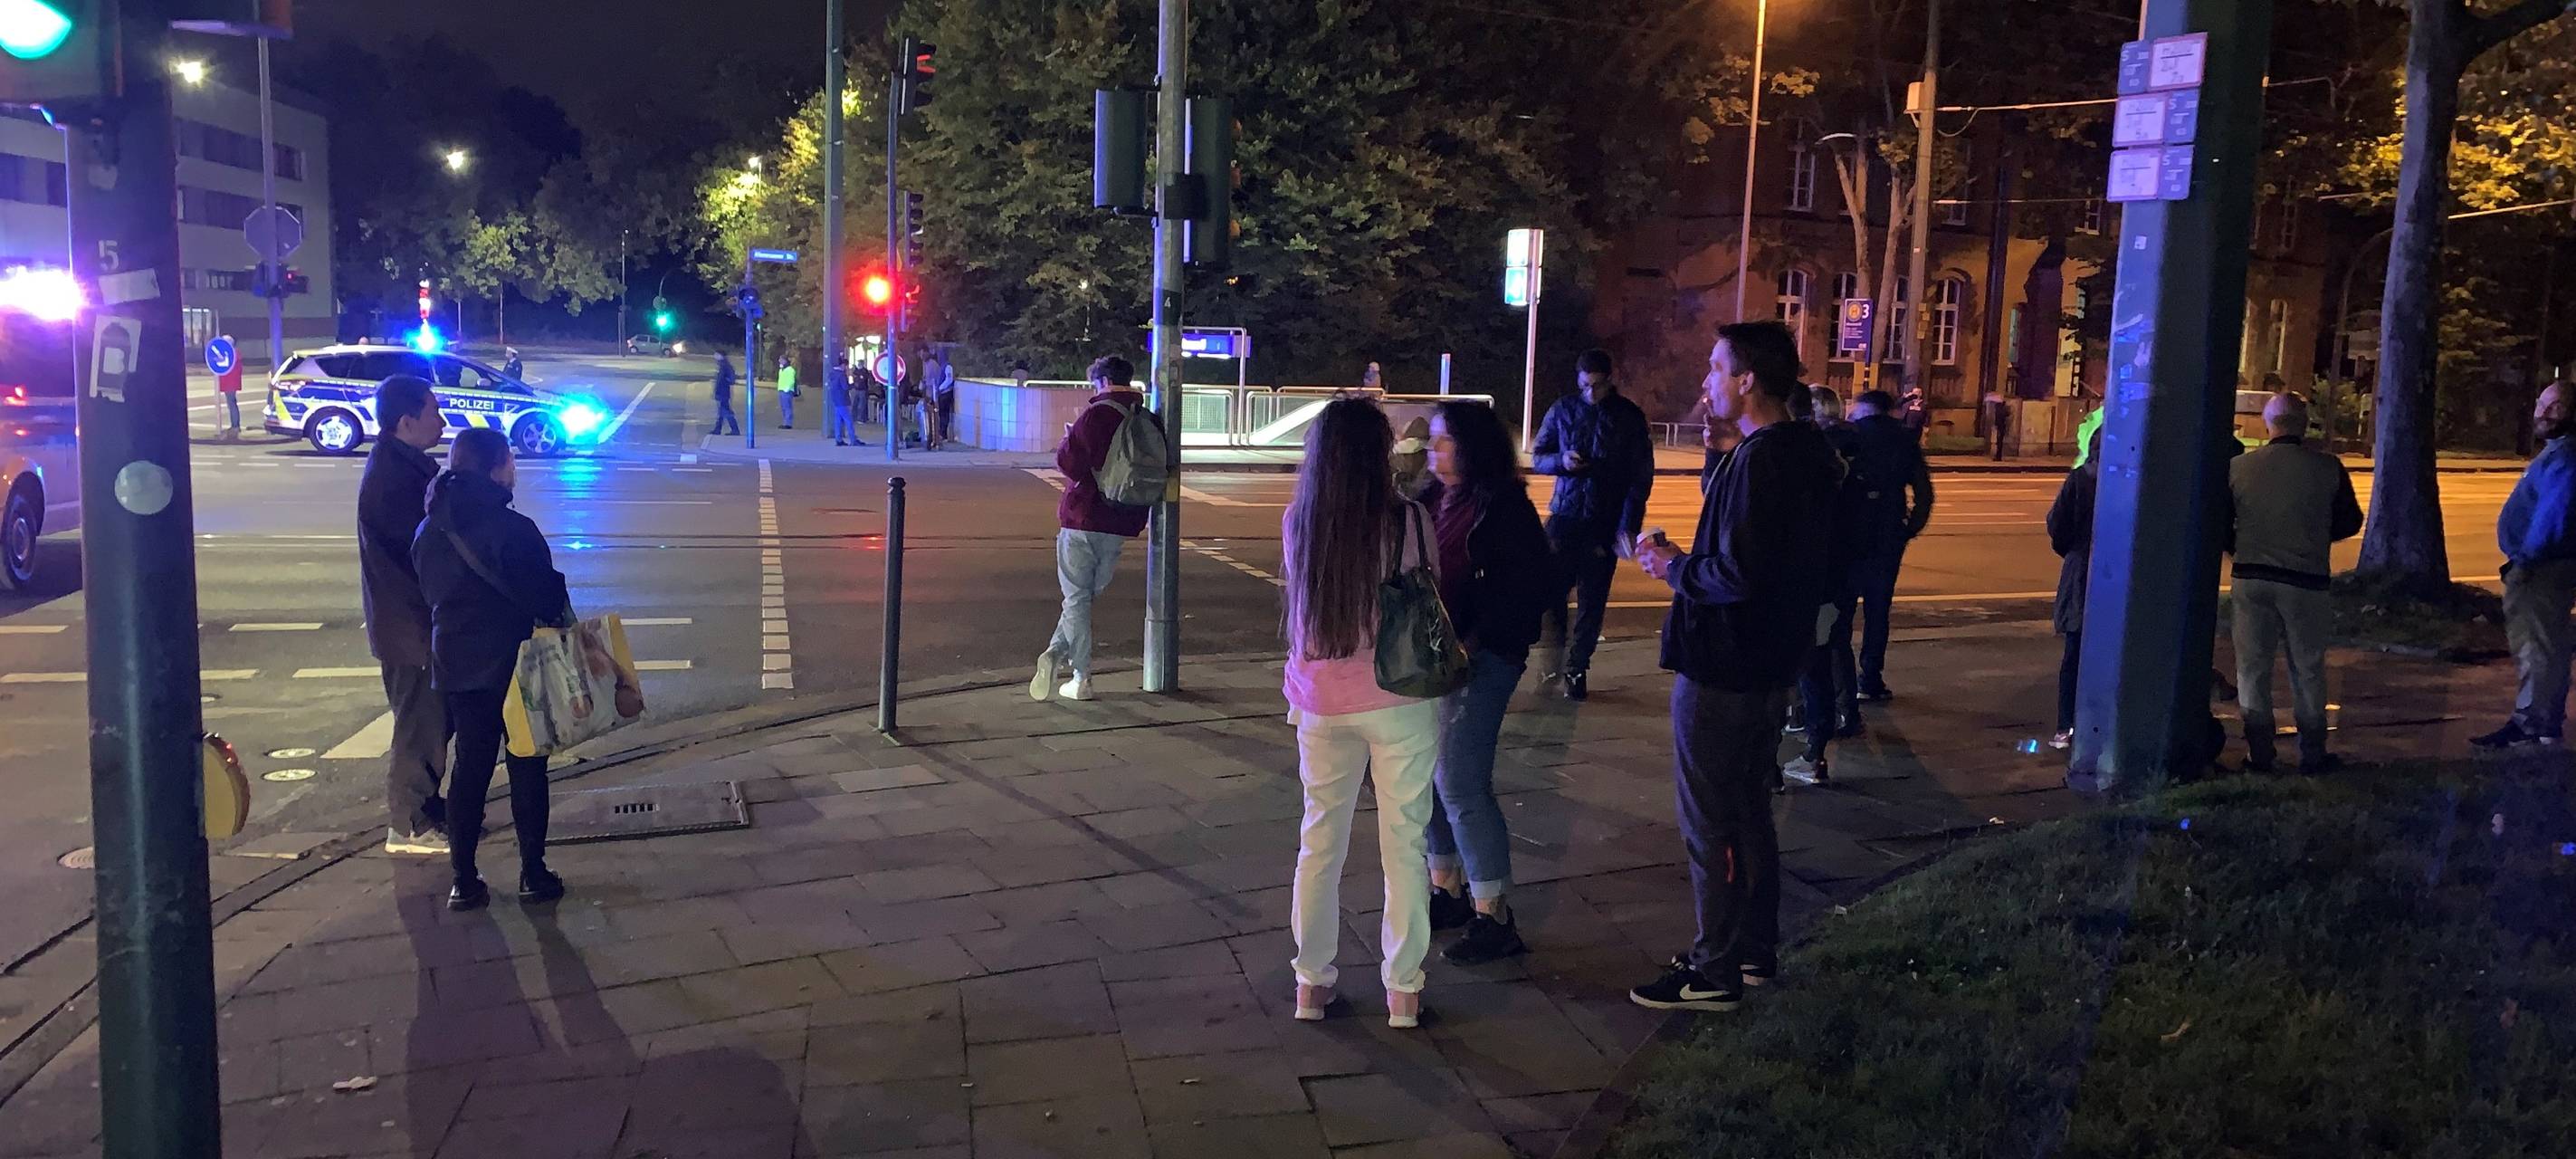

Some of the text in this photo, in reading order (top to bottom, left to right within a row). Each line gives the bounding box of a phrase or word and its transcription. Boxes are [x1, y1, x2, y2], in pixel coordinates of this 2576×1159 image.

[98, 240, 119, 271] 5
[1862, 303, 1870, 319] 3
[449, 398, 494, 410] POLIZEI
